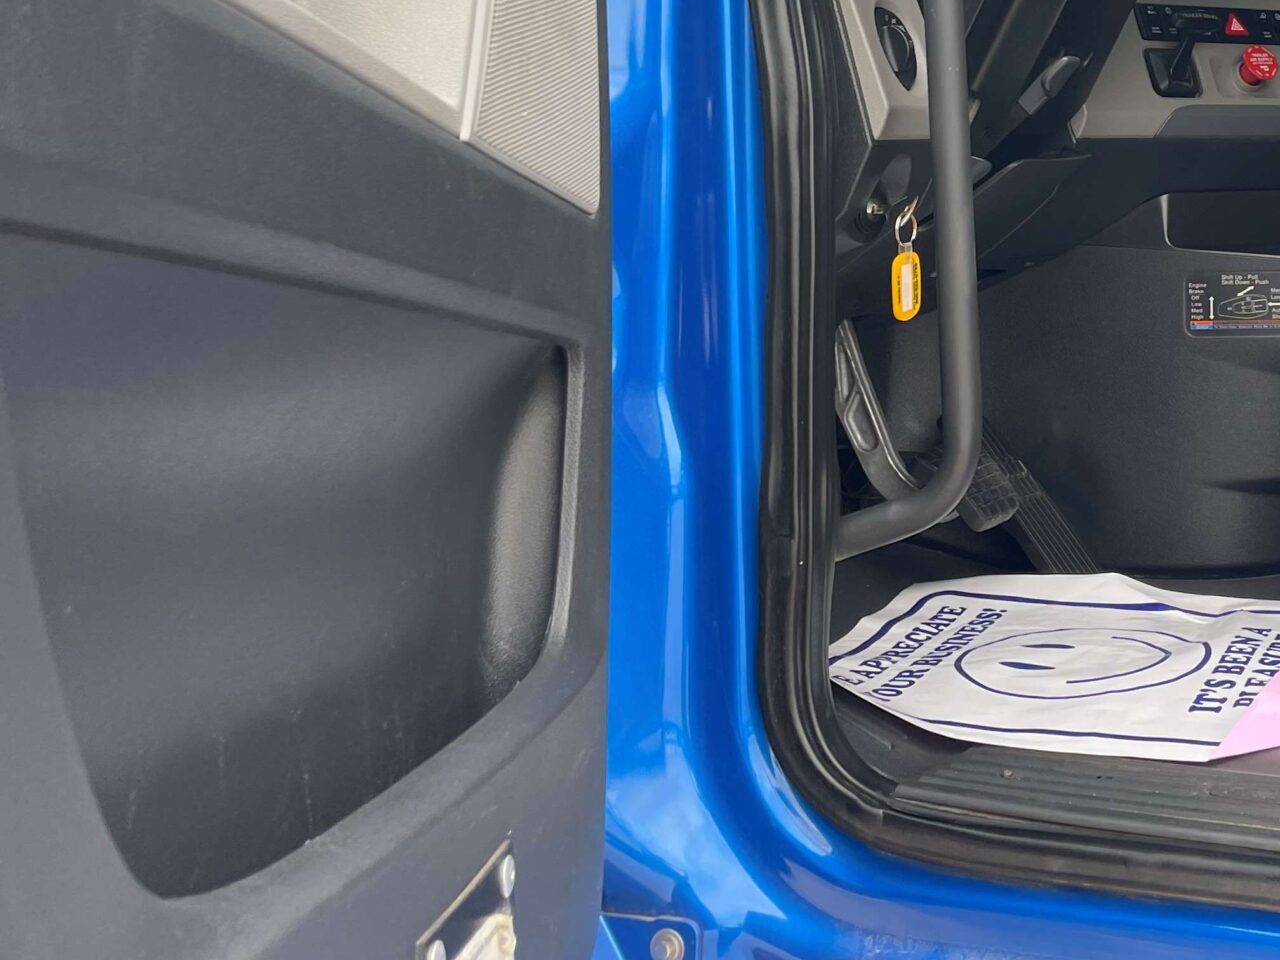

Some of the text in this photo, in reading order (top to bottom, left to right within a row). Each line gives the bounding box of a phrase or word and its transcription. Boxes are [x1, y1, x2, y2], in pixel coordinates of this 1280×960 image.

[849, 605, 968, 680] APPRECIATE
[909, 608, 1008, 667] BUSINESS!
[1187, 626, 1273, 715] IT'S BEEN A
